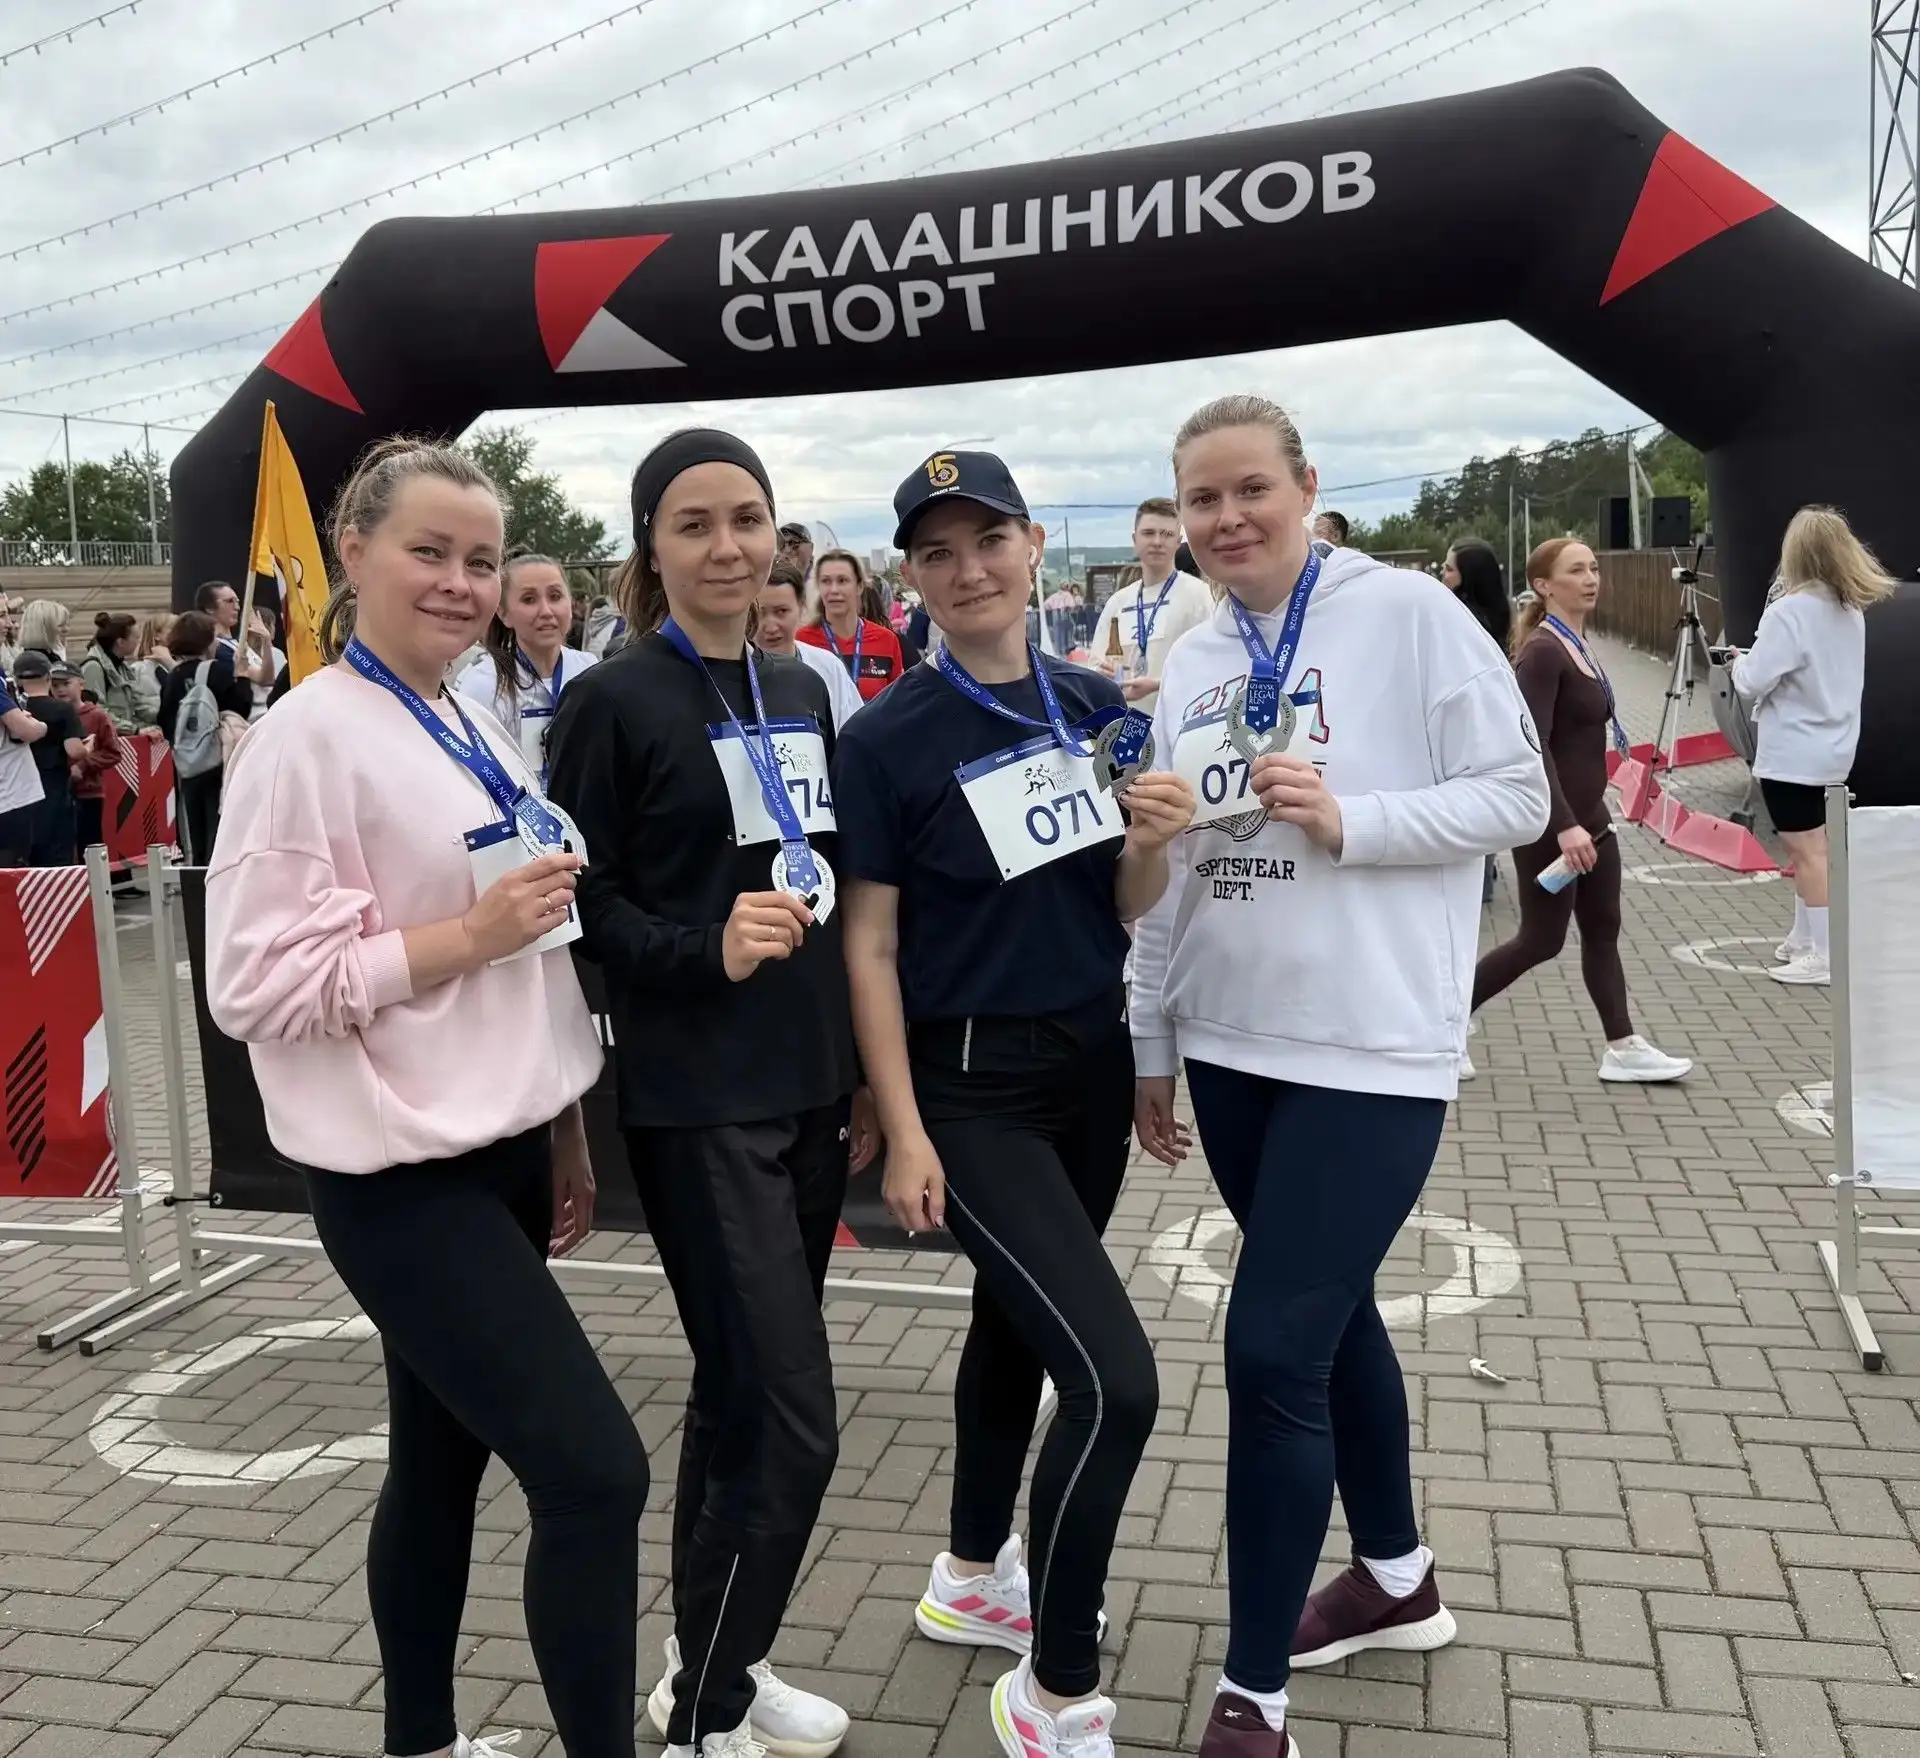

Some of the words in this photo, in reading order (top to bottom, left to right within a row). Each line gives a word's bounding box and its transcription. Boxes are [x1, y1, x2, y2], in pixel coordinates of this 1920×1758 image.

[718, 151, 1376, 286] КАЛАШНИКОВ
[720, 272, 995, 352] СПОРТ
[925, 454, 959, 487] 15
[1294, 591, 1305, 610] RUN
[951, 668, 980, 695] IZHEVSK
[1249, 690, 1276, 699] LEGAL
[1123, 721, 1146, 737] LEGAL
[481, 766, 501, 788] 2026
[1201, 757, 1250, 805] 07
[768, 777, 834, 818] 74
[1025, 788, 1103, 846] 071
[785, 849, 809, 859] LEGAL
[1213, 880, 1254, 901] DEPT.
